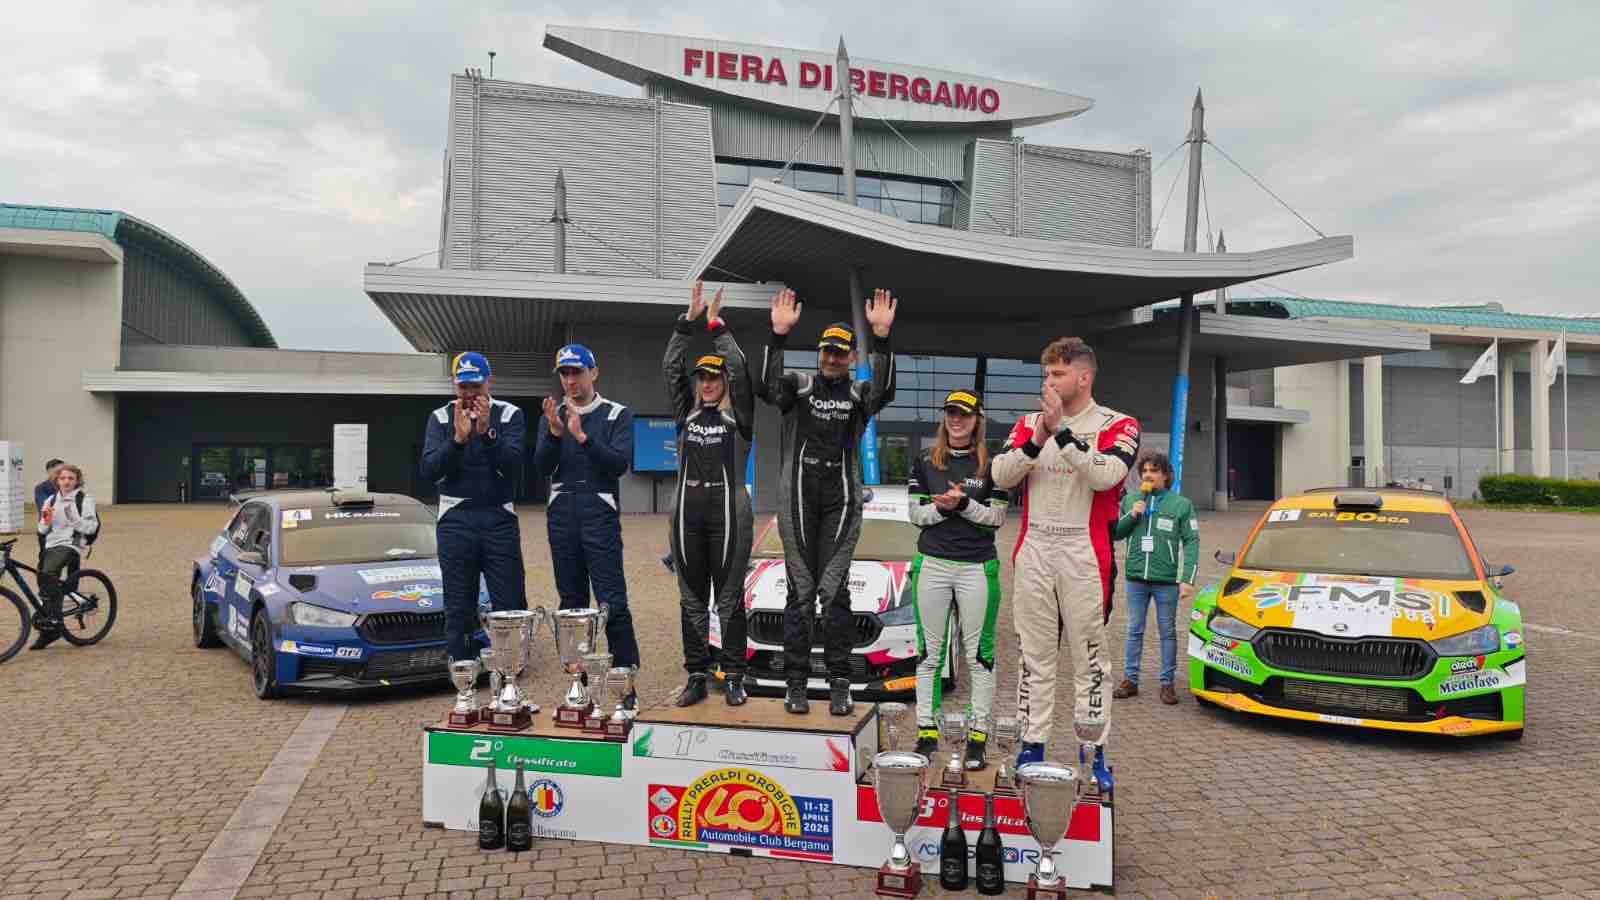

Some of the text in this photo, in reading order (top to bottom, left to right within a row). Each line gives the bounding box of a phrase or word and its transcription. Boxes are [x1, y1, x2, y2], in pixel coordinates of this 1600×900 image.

[683, 47, 1001, 115] FIERA DI BERGAMO
[1288, 585, 1432, 611] FMS
[1440, 675, 1500, 694] Medolago
[682, 770, 797, 838] RALLY PREALPI OROBICHE
[804, 801, 830, 813] 11-12
[802, 813, 829, 822] APRILE
[701, 830, 830, 852] Automobile Club Bergamo
